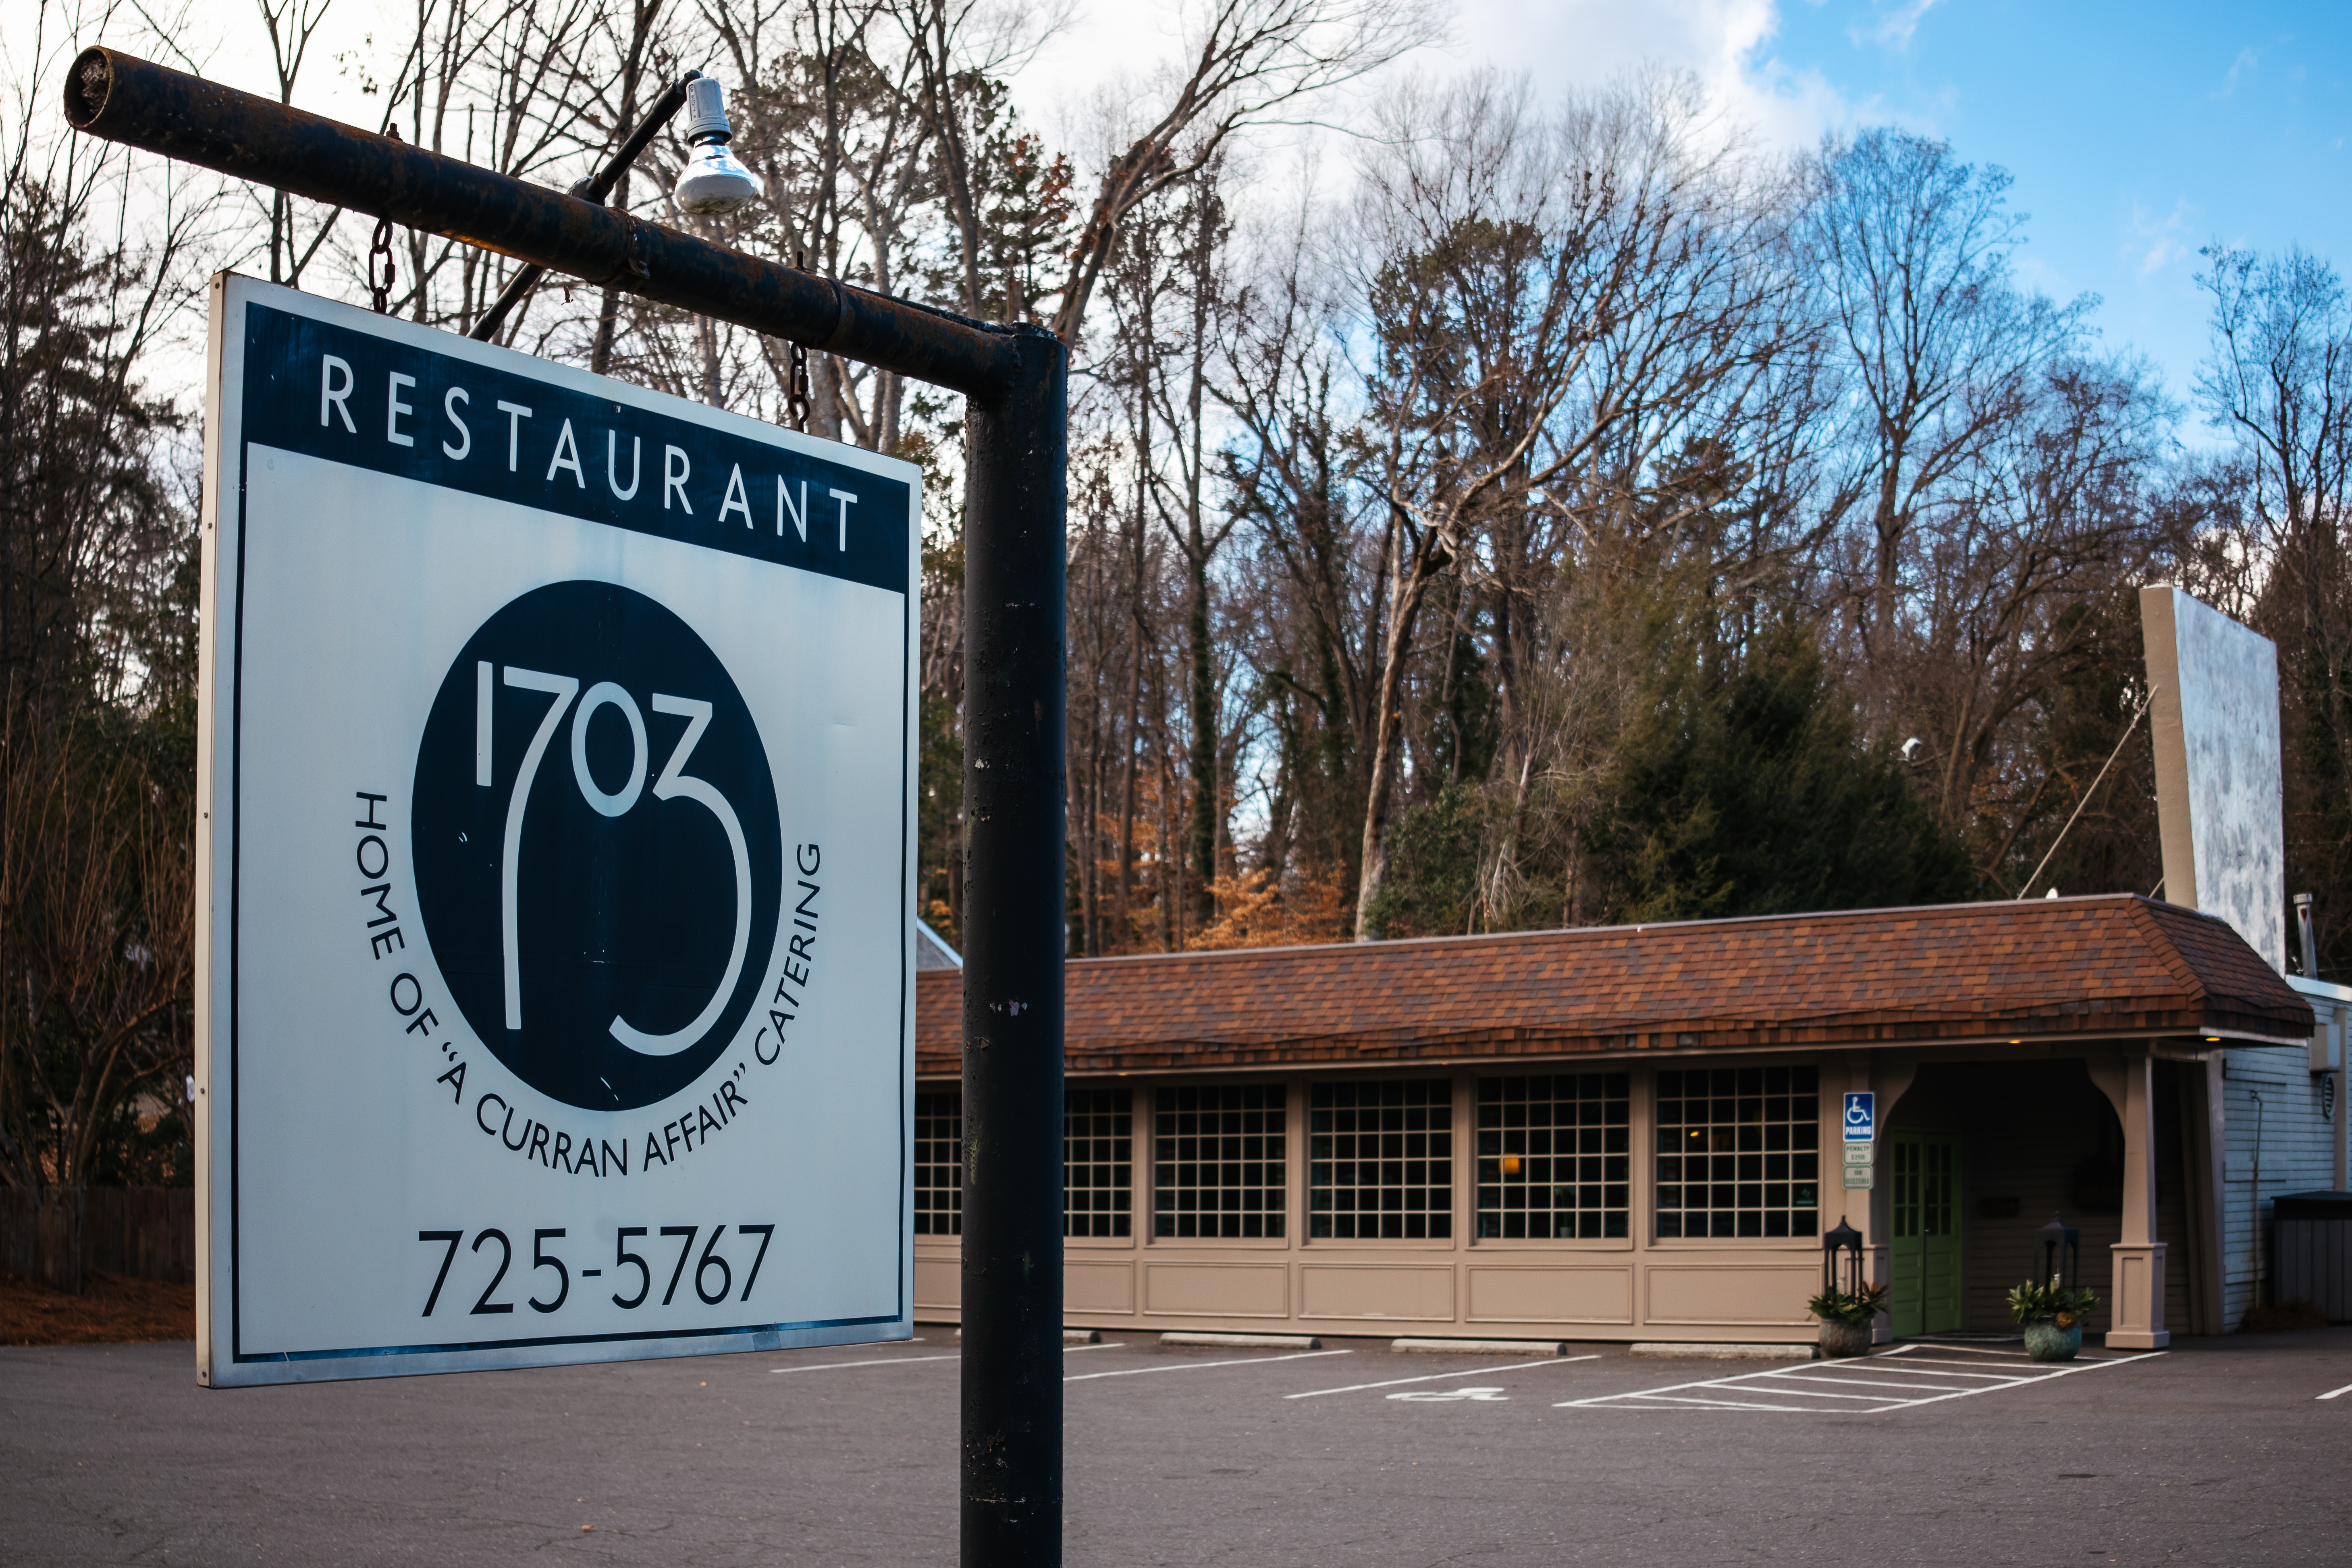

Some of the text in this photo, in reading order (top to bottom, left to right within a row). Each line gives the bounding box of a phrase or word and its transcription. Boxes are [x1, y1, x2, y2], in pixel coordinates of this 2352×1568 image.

[321, 353, 858, 552] RESTAURANT
[476, 660, 752, 1056] 1703
[355, 791, 405, 961] HOME
[390, 972, 439, 1037] OF
[476, 1093, 627, 1178] CURRAN
[754, 843, 821, 1066] CATERING
[1845, 1126, 1871, 1135] PARKING
[418, 1223, 776, 1317] 725-5767
